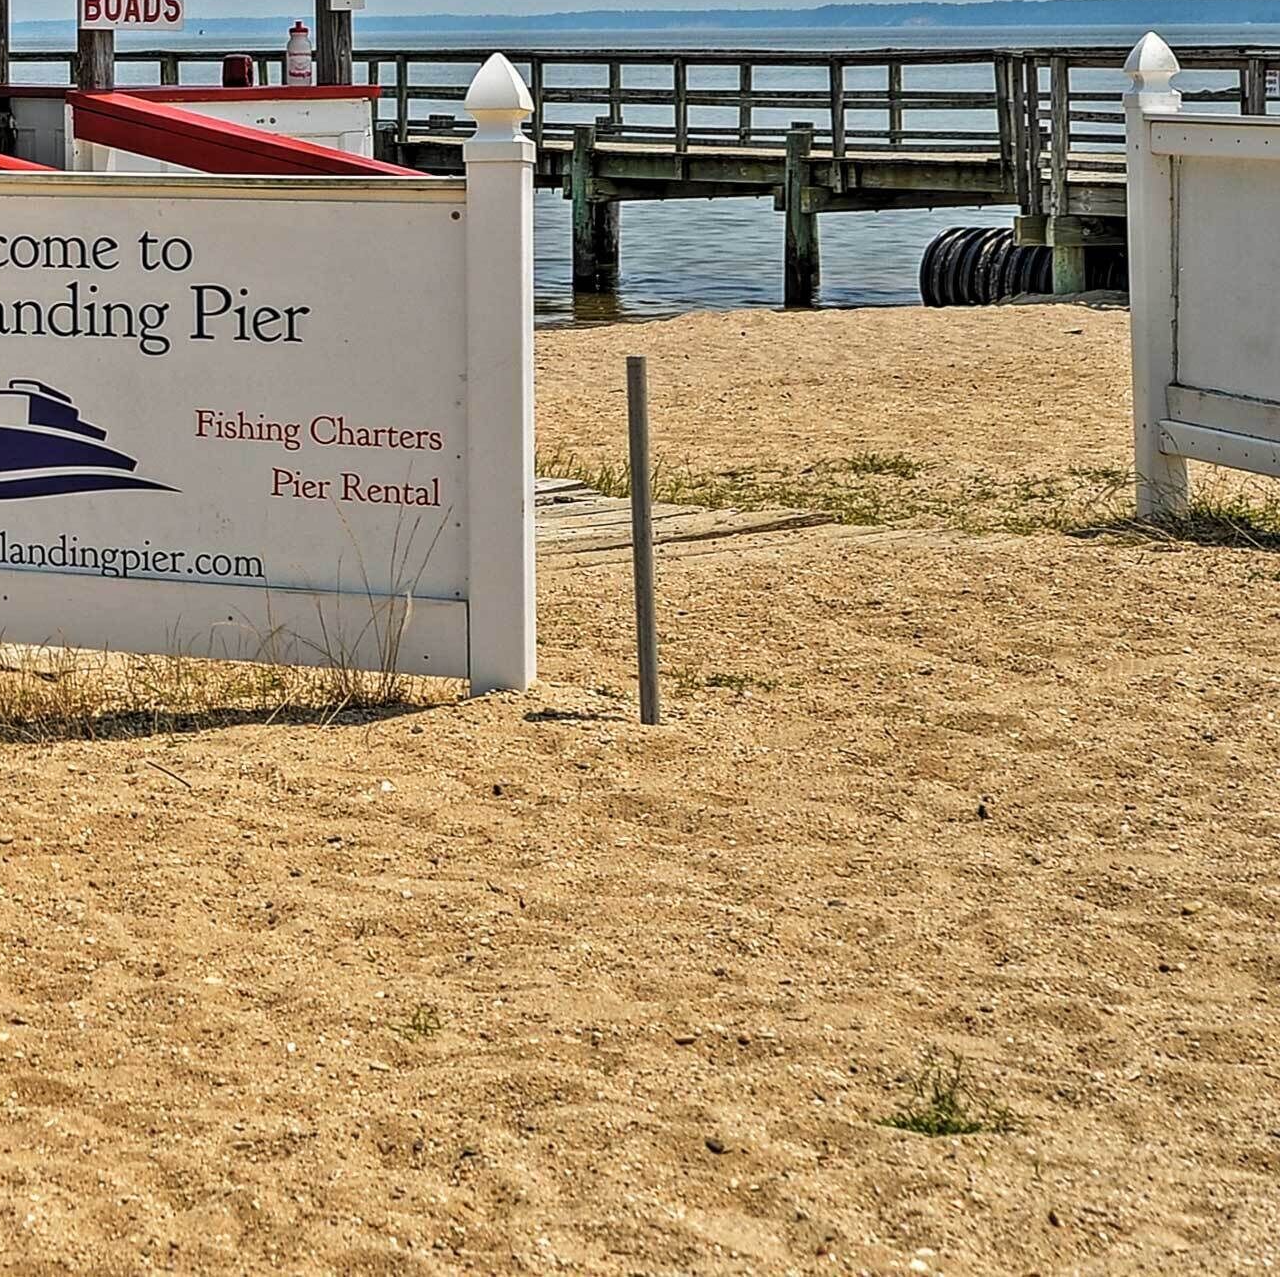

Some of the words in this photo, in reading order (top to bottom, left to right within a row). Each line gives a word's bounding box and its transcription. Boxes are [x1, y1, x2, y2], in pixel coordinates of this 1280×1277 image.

[137, 230, 193, 272] to
[189, 284, 311, 343] Pier
[195, 409, 301, 451] Fishing
[310, 416, 443, 451] Charters
[270, 466, 332, 500] Pier
[340, 472, 442, 507] Rental
